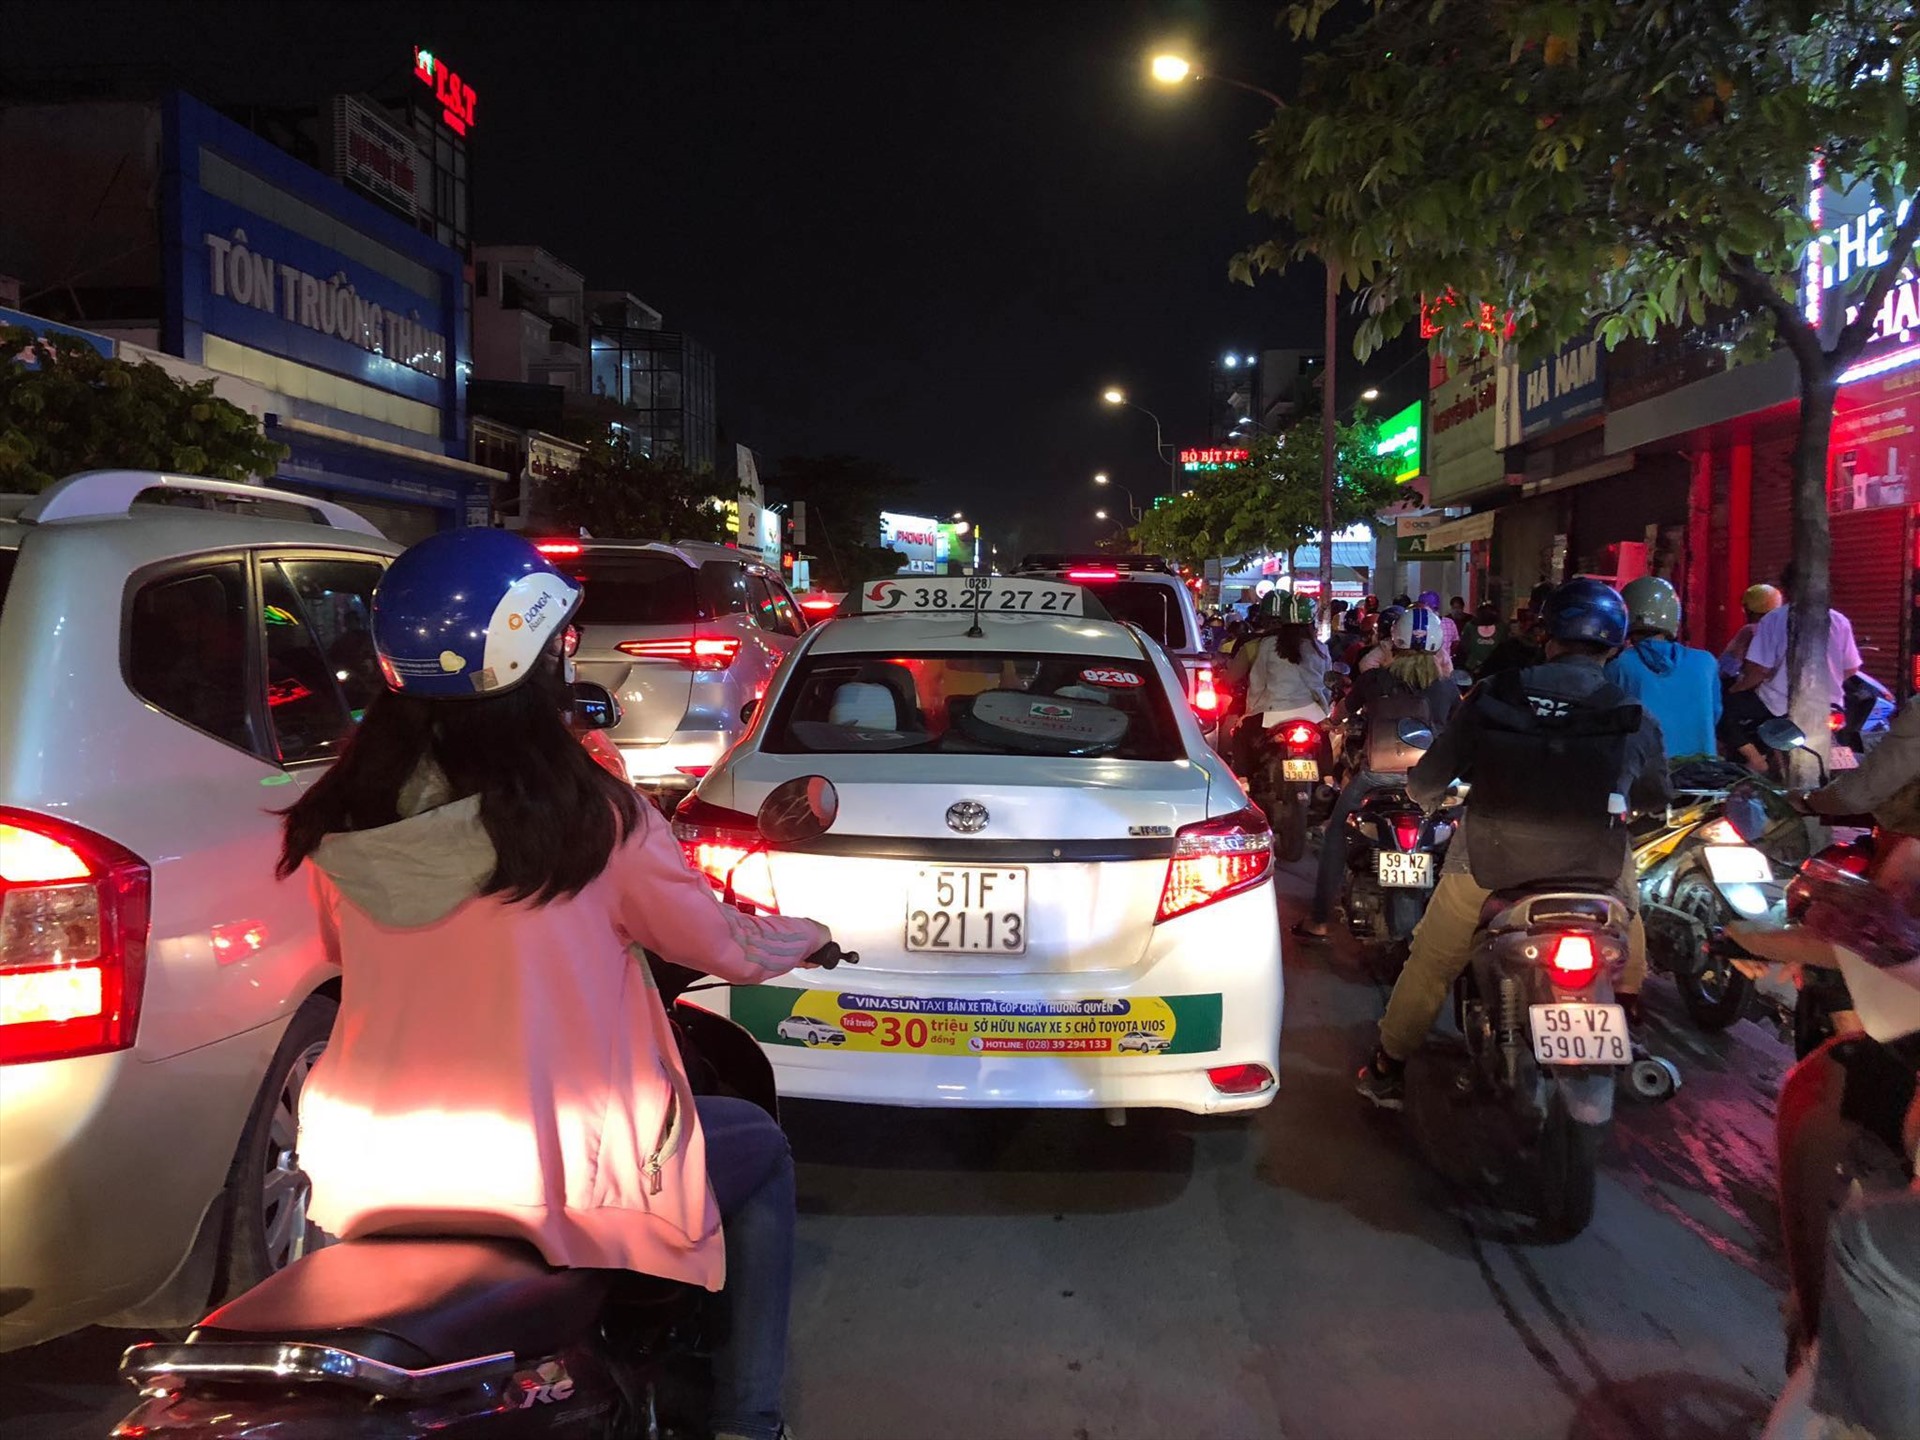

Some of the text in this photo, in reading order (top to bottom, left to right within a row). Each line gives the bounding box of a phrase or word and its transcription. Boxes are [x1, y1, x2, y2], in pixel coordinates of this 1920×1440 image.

[205, 228, 275, 313] TÔN
[1554, 340, 1598, 398] NAM
[964, 577, 991, 589] (028)
[914, 588, 1077, 611] 38.27 27 27
[1083, 669, 1139, 684] 9230
[937, 872, 997, 908] 51F
[910, 910, 1021, 949] 321.13
[968, 1003, 978, 1012] XE
[880, 1017, 928, 1048] 30
[931, 1019, 968, 1035] triệu
[974, 1017, 1165, 1033] SỞ HỮU NGAY XE 5 CHỖ TOYOTA VIOS
[1026, 1040, 1050, 1050] (028)
[1052, 1041, 1065, 1049] 39
[1067, 1041, 1085, 1050] 294
[1089, 1041, 1107, 1049] 133
[1541, 1036, 1624, 1059] 590.78
